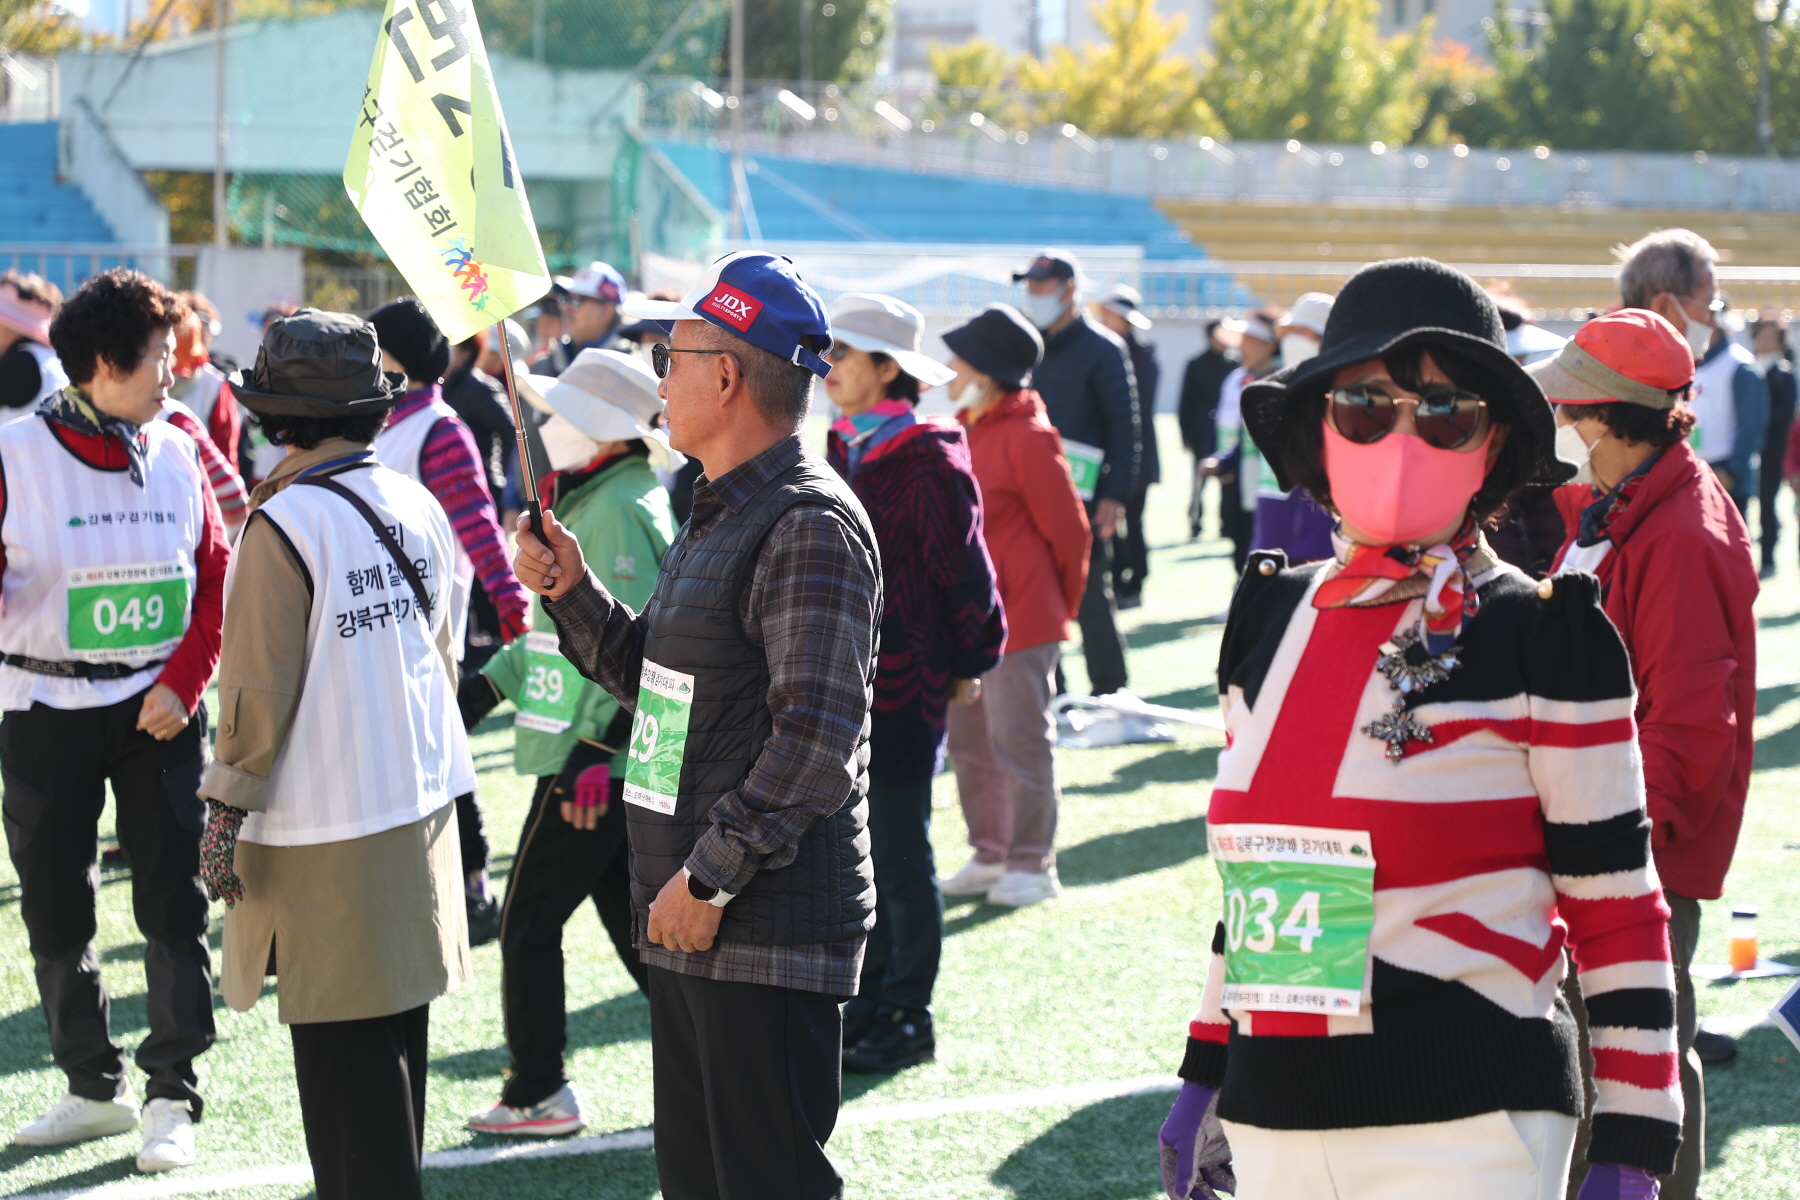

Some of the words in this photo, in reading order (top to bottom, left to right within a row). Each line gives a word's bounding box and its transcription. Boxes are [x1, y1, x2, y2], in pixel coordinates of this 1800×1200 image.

[711, 302, 743, 322] MULTISPORTS
[714, 293, 753, 318] JDX
[87, 511, 176, 526] 강북구걷기협회
[346, 563, 385, 597] 함께
[93, 594, 164, 636] 049
[1236, 835, 1298, 854] 강북구청장배
[1301, 838, 1345, 857] 걷기대회
[1228, 886, 1324, 953] 034
